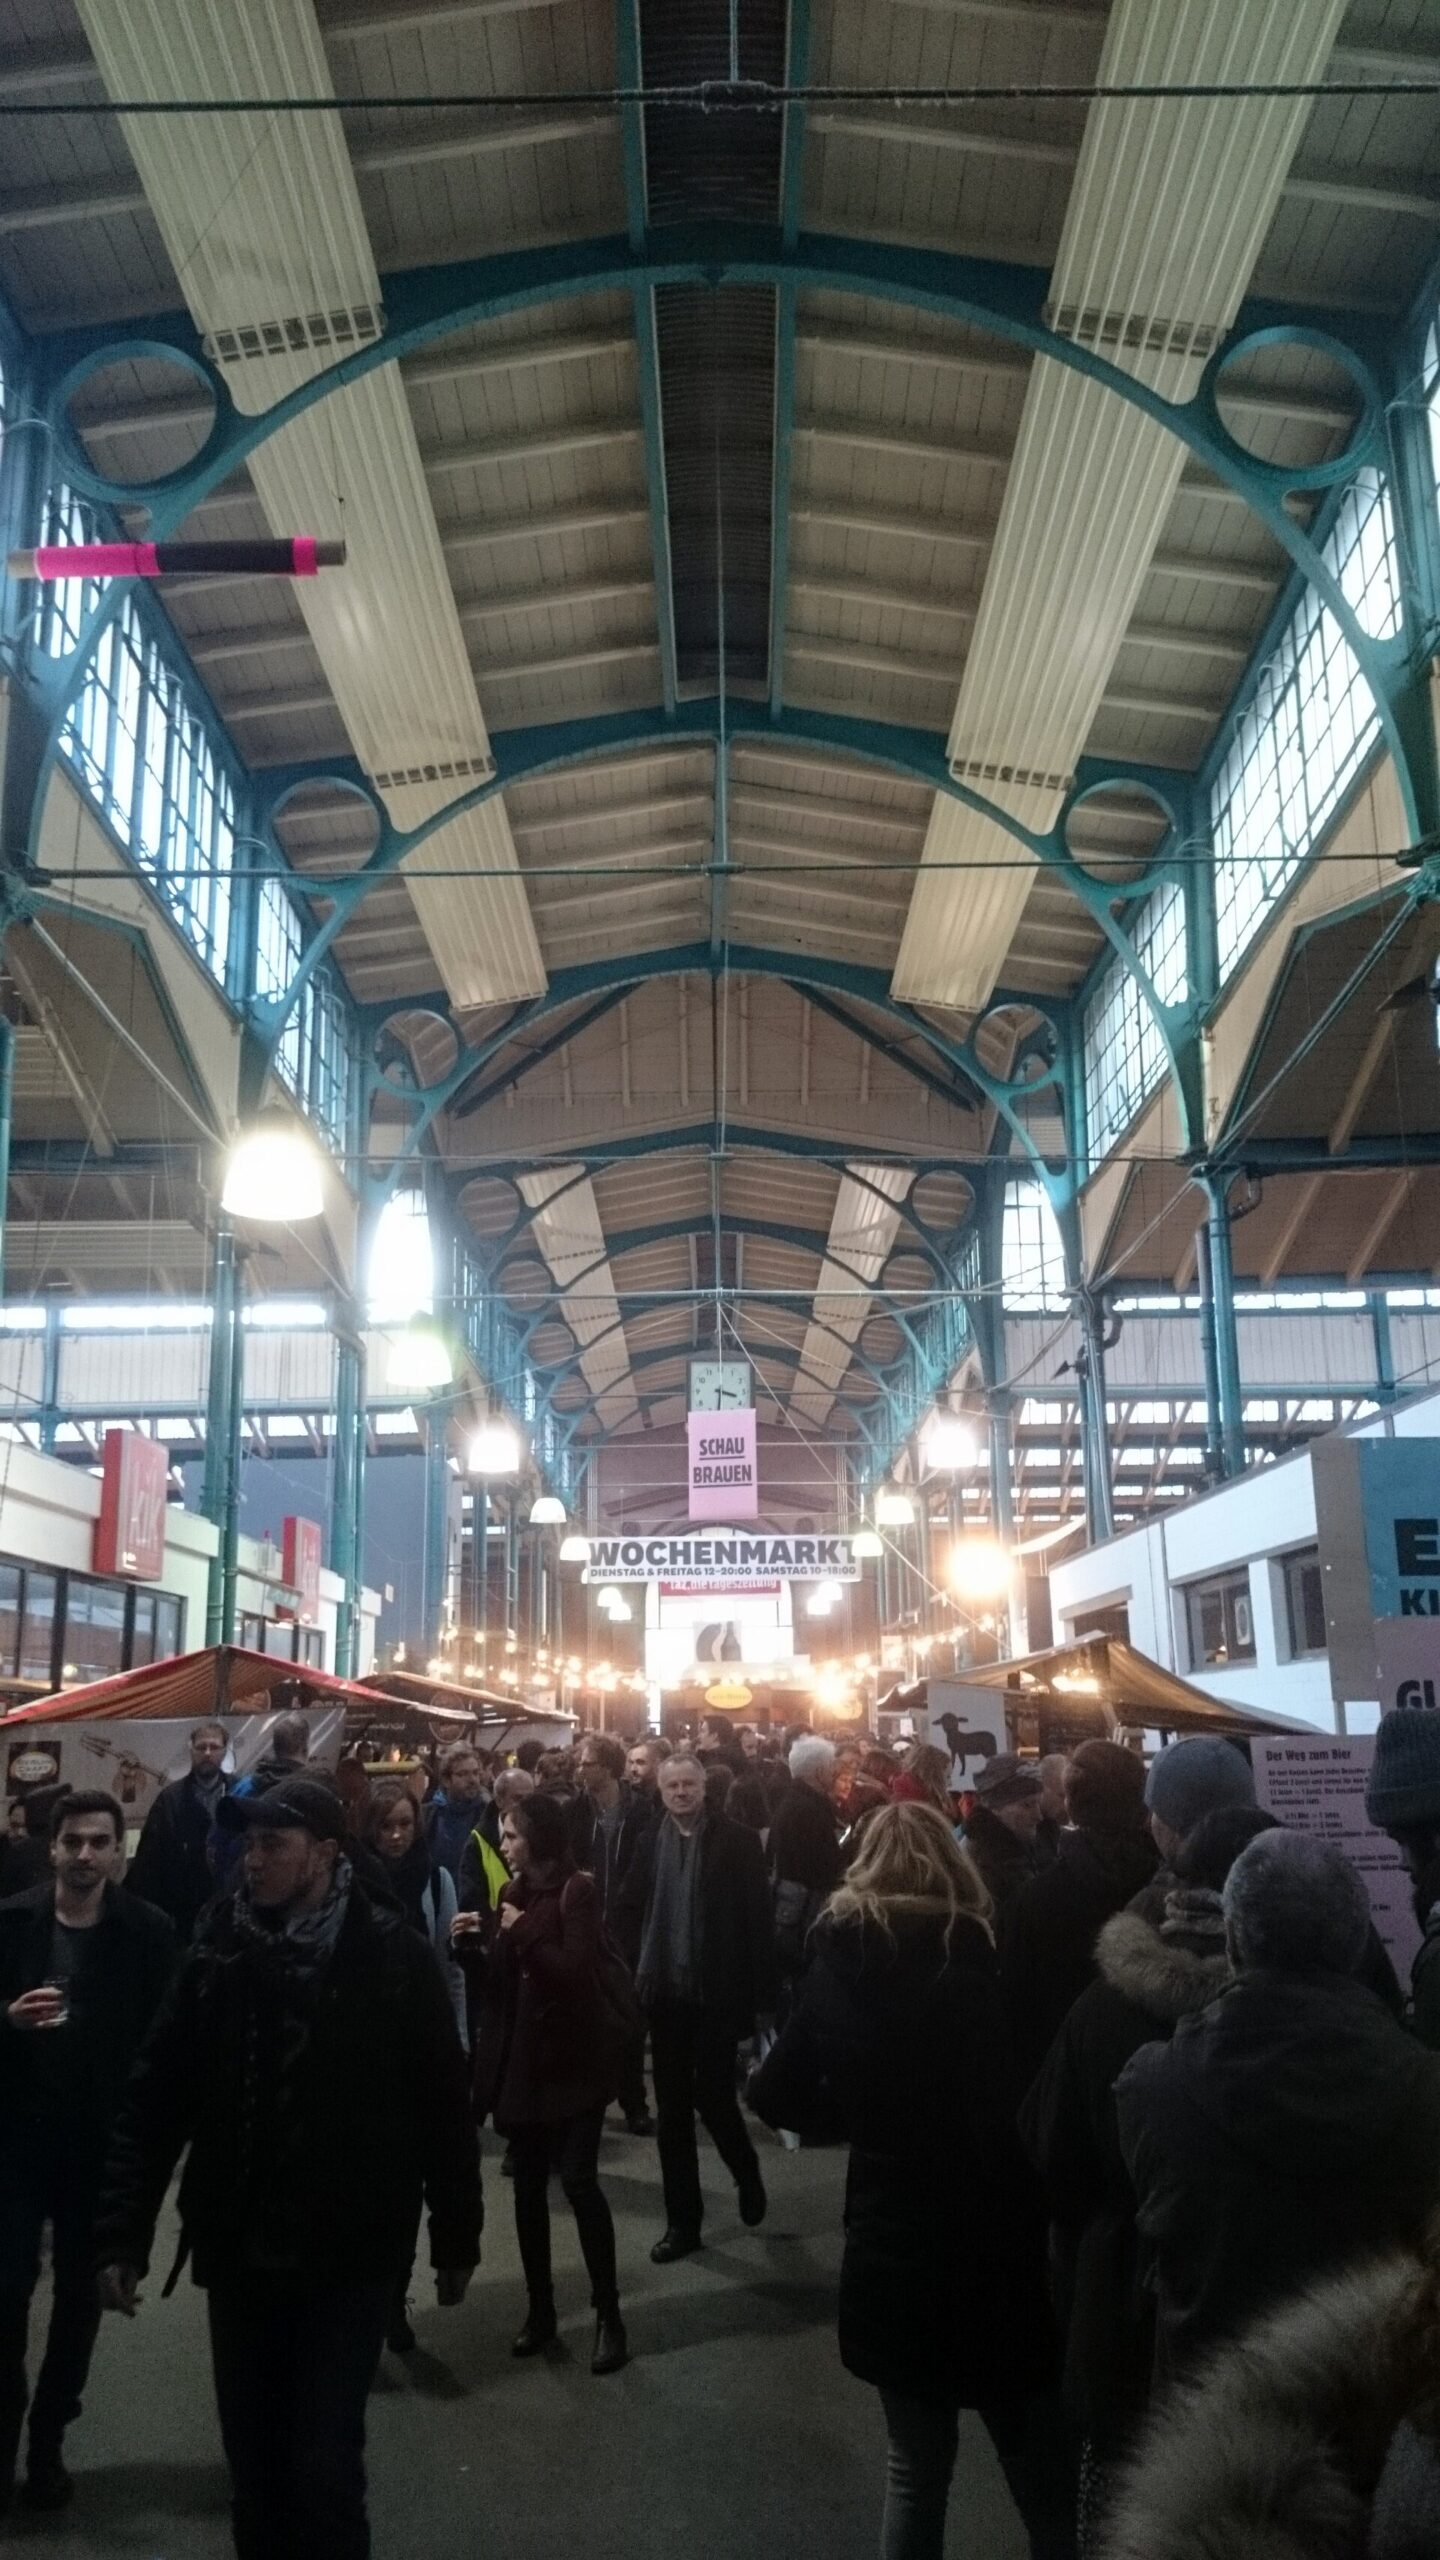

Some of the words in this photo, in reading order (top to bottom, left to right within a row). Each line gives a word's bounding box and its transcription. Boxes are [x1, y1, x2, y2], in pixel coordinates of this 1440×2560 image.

[699, 1437, 745, 1456] SCHAU
[693, 1464, 752, 1484] BRAUEN
[588, 1540, 857, 1567] WOCHENMARKT
[590, 1568, 645, 1577] DIENSTAG
[647, 1568, 655, 1577] &
[657, 1567, 702, 1576] FREITAG
[756, 1566, 808, 1575] SAMSTAG
[1266, 1751, 1282, 1761] Der
[1285, 1750, 1306, 1762] Weg
[1309, 1751, 1329, 1761] zum
[1331, 1748, 1351, 1760] Bier
